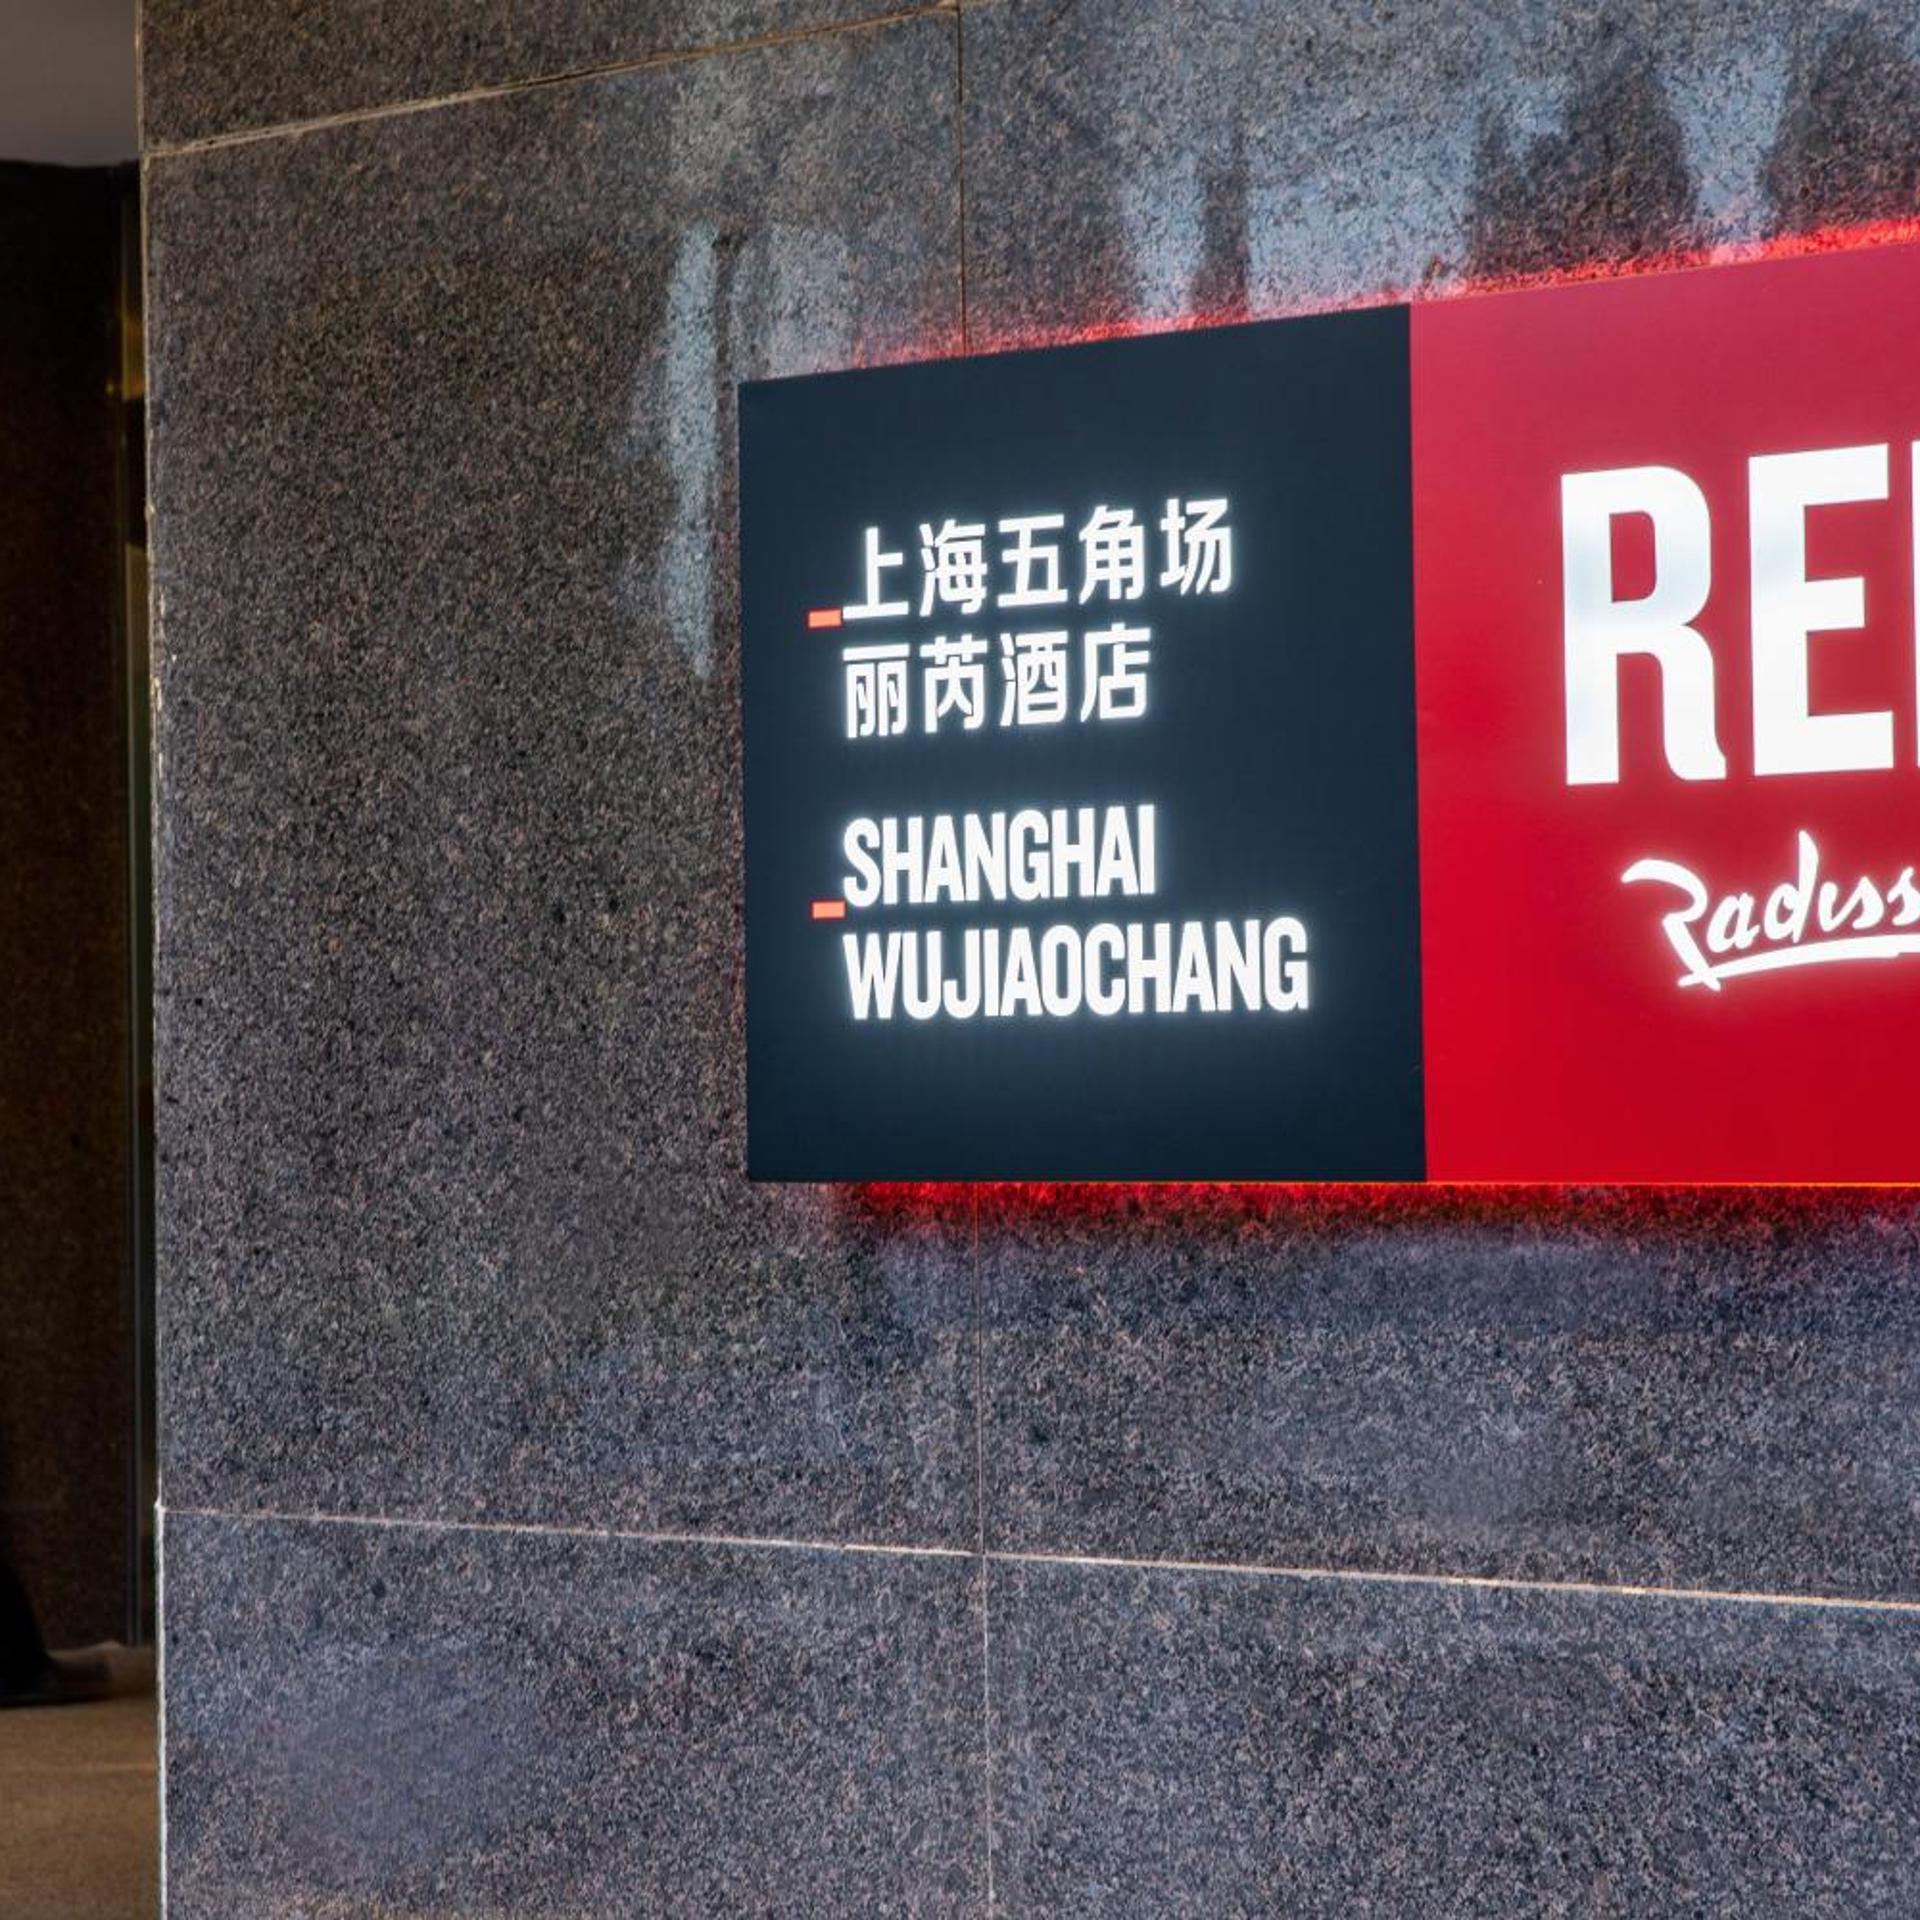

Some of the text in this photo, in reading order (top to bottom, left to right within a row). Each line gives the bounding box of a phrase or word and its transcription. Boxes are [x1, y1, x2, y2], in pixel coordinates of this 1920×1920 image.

[841, 496, 1233, 622] 上海五角场
[1560, 439, 1920, 786] RE
[841, 621, 1153, 740] 丽芮酒店
[842, 803, 1157, 908] SHANGHAI
[841, 915, 1310, 1021] WUJIAOCHANG
